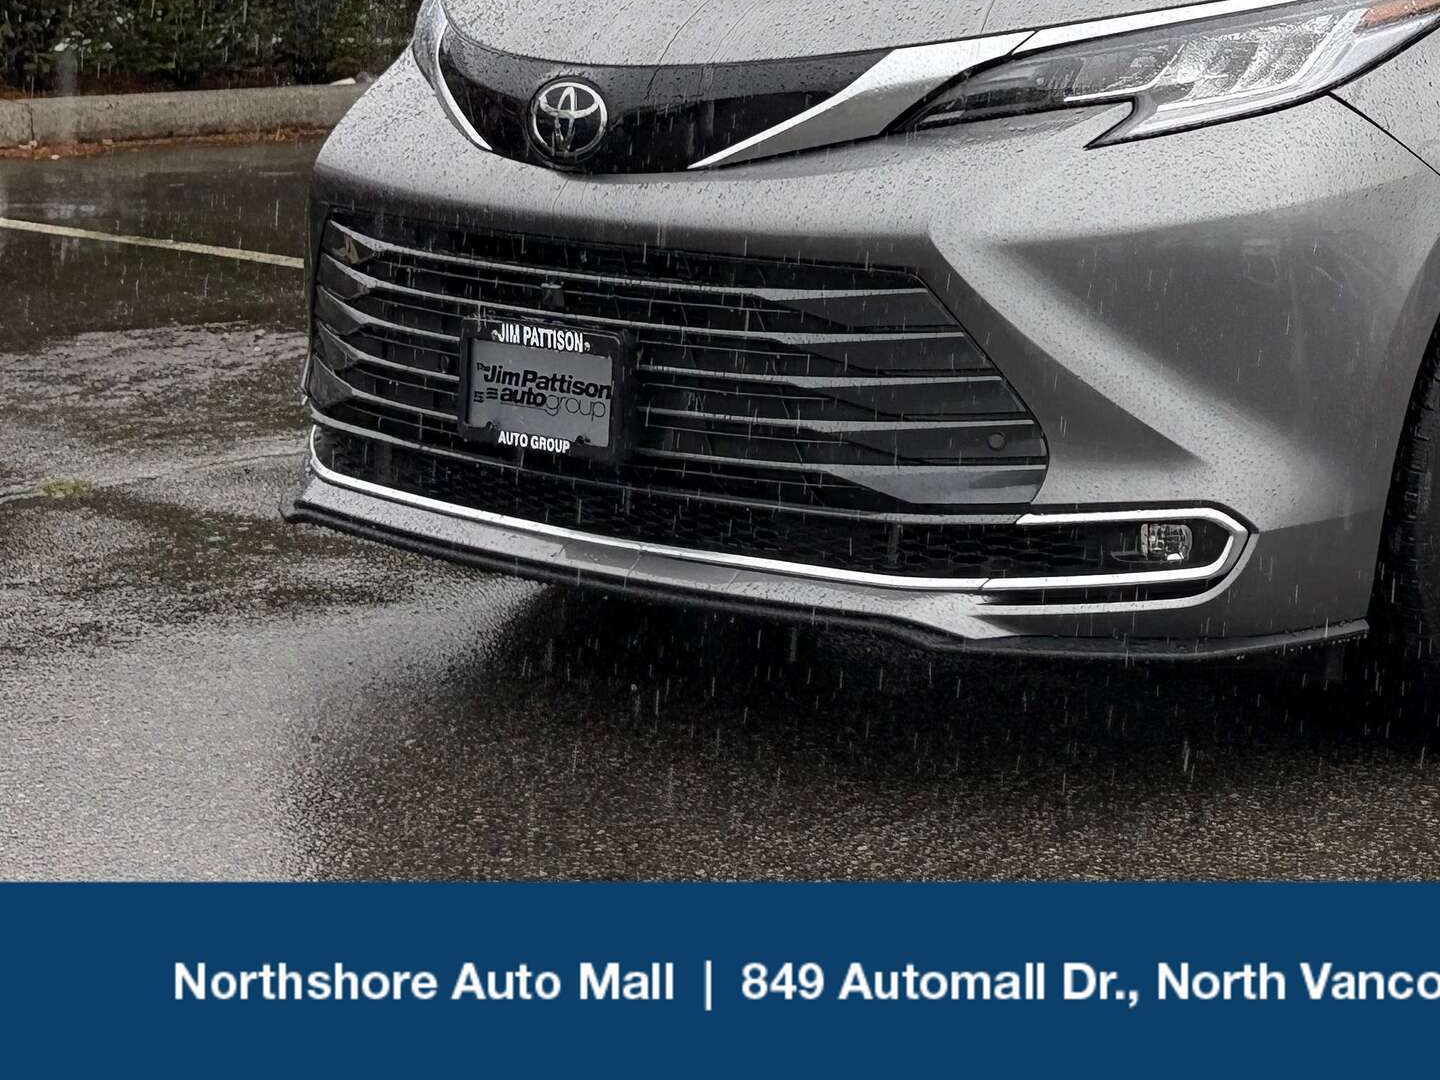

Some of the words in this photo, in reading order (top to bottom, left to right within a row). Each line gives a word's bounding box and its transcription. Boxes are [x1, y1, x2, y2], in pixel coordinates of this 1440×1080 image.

[500, 323, 520, 344] JIM
[523, 326, 584, 352] PATTISON
[498, 430, 528, 448] AUTO
[530, 435, 570, 454] GROUP
